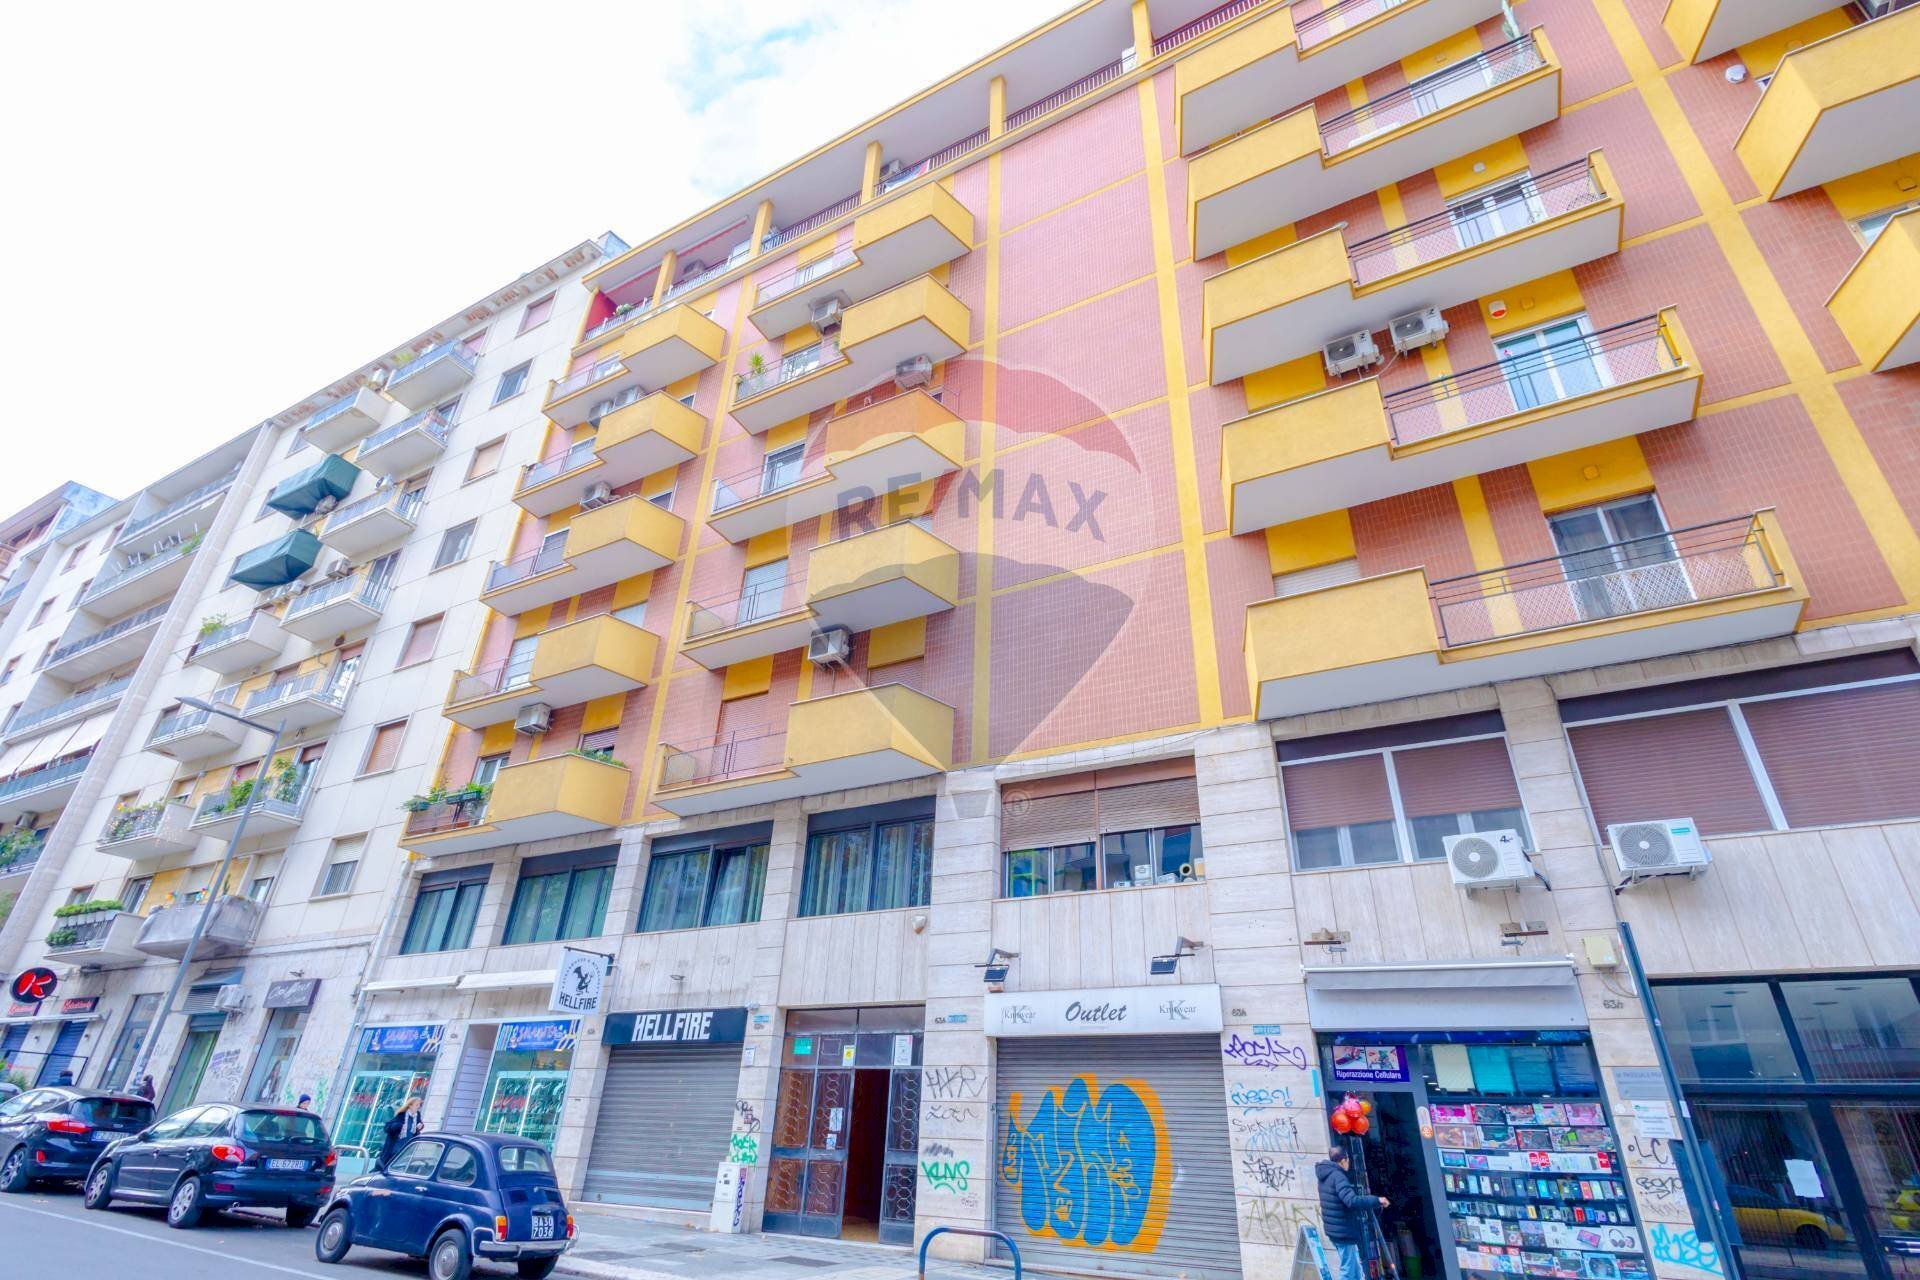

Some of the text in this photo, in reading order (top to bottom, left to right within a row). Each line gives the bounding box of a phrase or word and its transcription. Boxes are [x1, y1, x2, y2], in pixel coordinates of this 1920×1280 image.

[17, 972, 53, 998] K
[559, 992, 598, 1010] HELLFIRE
[1065, 1001, 1127, 1022] Outlet
[631, 1012, 714, 1042] HELLFIRE
[1374, 1071, 1402, 1080] Cellulare
[533, 1226, 553, 1238] 7036
